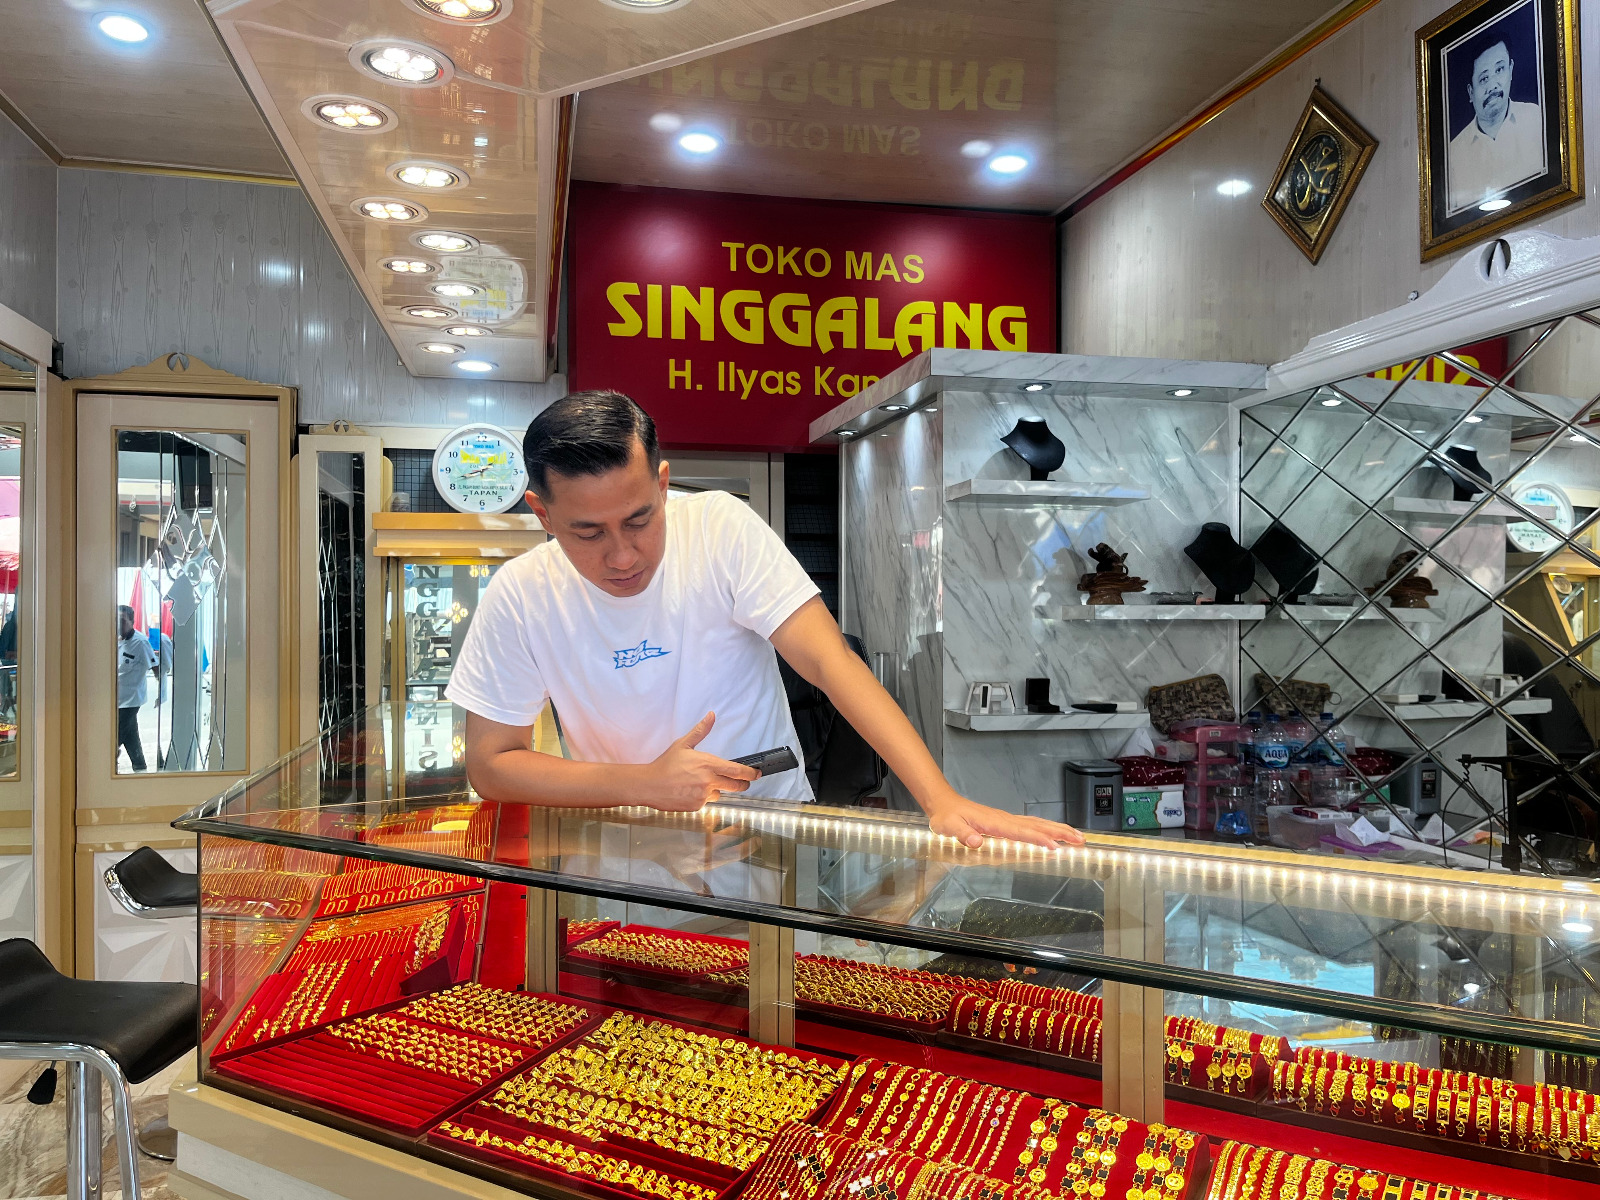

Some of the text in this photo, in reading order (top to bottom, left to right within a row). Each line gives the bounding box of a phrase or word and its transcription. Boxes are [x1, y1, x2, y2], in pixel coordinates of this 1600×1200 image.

[722, 240, 925, 284] TOKO MAS
[606, 281, 1028, 358] SINGGALANG
[668, 358, 703, 391] H.
[717, 360, 801, 400] Ilyas
[1265, 750, 1288, 759] AQUA
